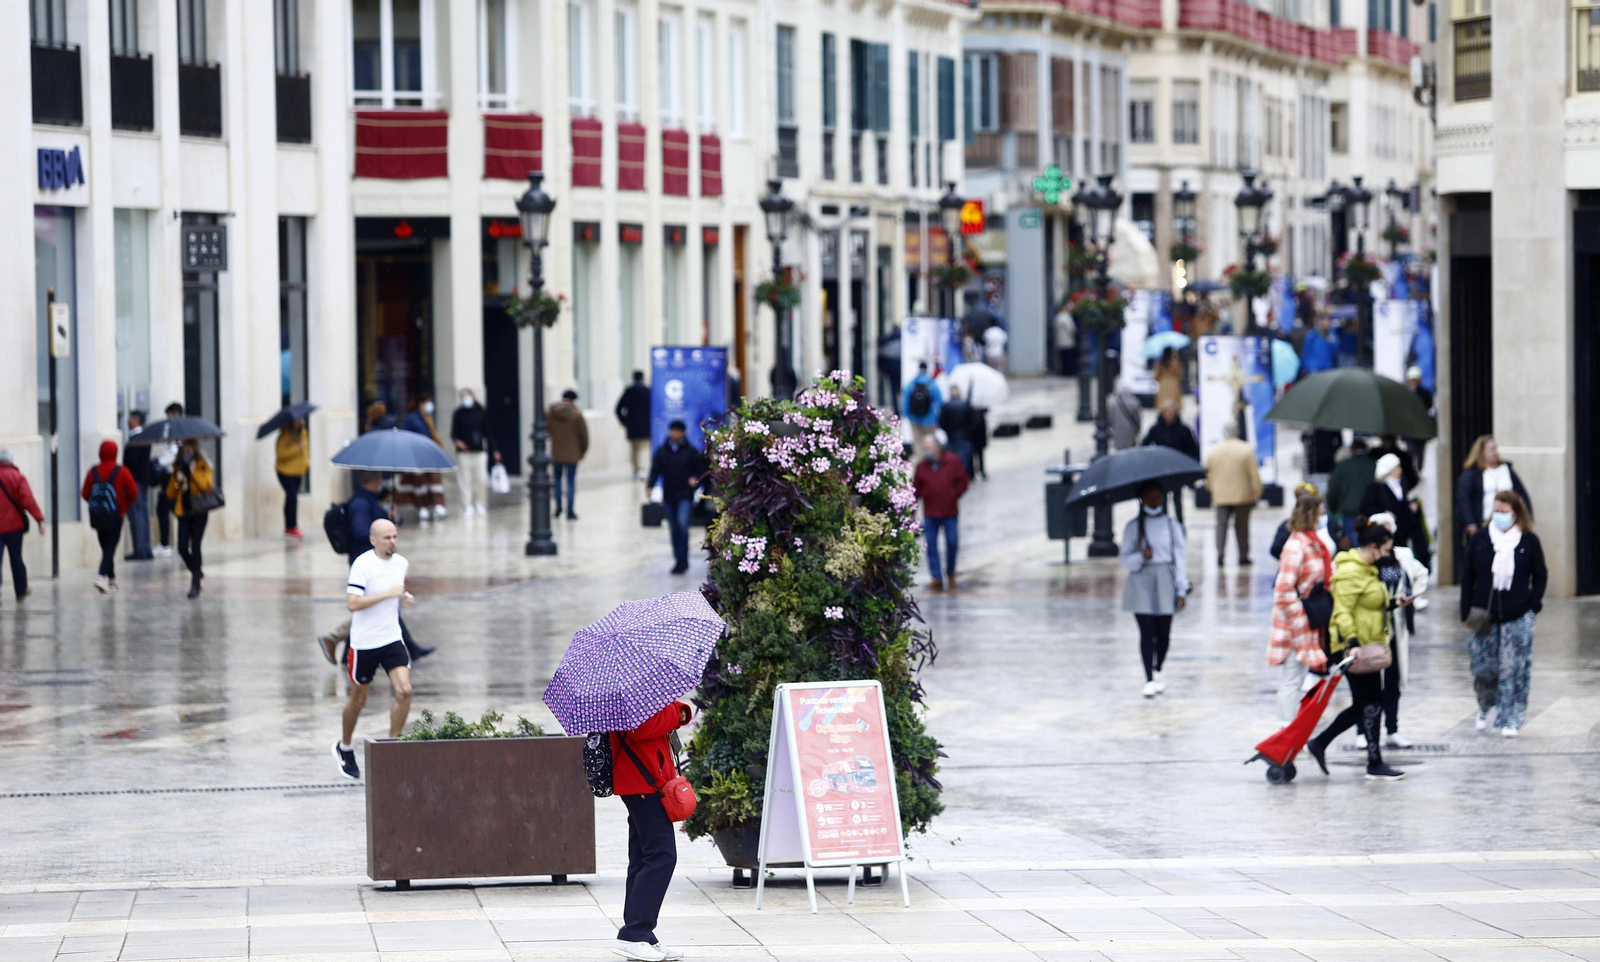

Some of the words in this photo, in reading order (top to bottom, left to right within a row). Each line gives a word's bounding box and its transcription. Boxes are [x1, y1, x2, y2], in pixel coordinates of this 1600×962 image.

[37, 145, 85, 190] BBVA
[799, 697, 819, 705] Punto
[814, 706, 838, 714] Tickets
